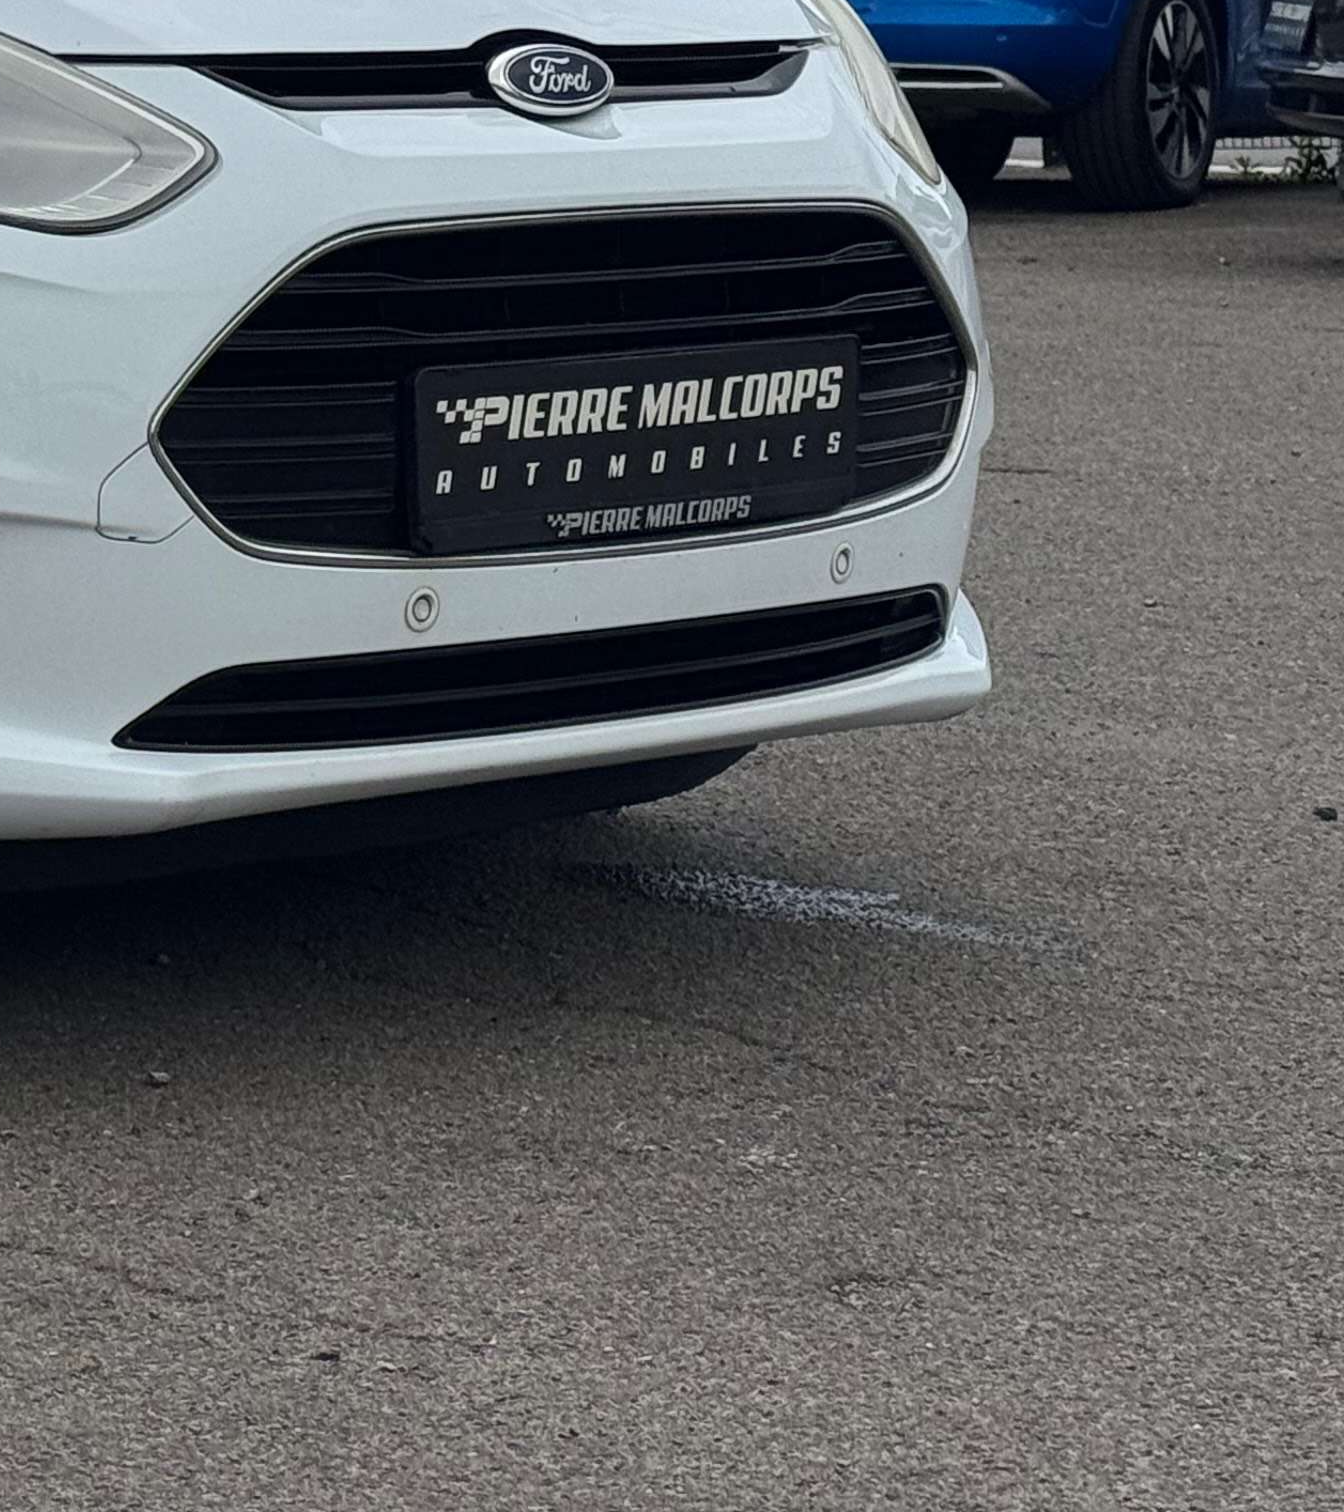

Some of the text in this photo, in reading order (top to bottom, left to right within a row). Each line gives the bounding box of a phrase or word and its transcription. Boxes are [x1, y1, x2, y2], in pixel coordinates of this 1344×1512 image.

[529, 55, 591, 94] Ford
[458, 365, 844, 445] PIERRE MALCORPS
[436, 431, 842, 495] AUTOMOBILES
[557, 495, 752, 538] PIERRE MALCORPS
